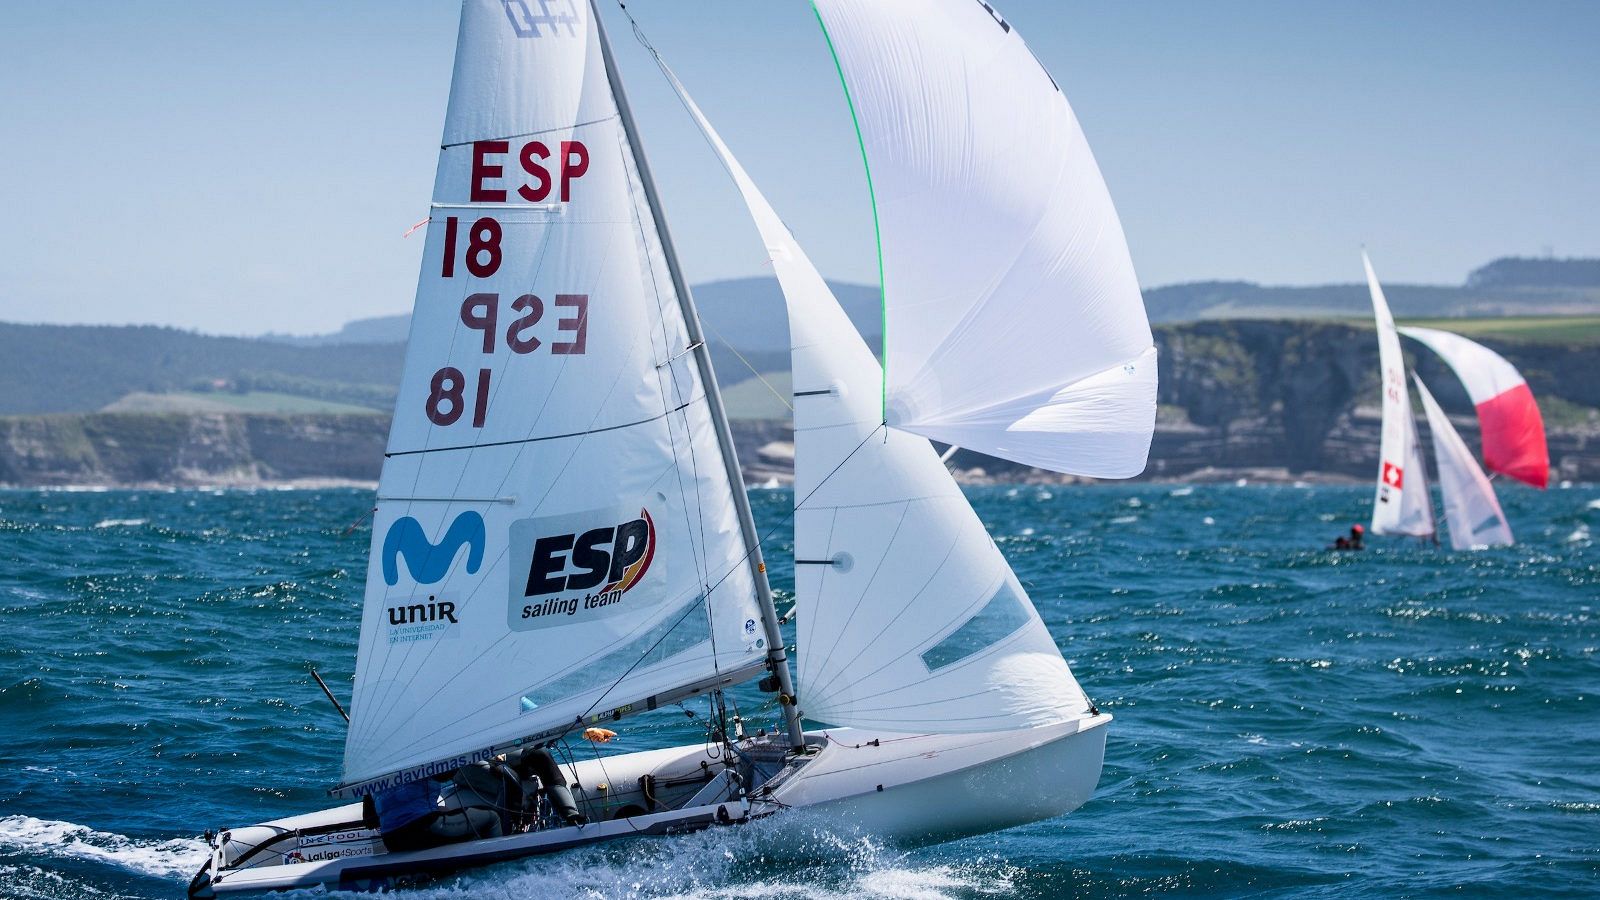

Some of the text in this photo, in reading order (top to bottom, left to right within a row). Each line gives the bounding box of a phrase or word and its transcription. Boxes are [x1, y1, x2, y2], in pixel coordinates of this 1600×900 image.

[470, 140, 590, 203] ESP
[441, 216, 503, 278] 18
[524, 518, 650, 597] ESP
[521, 589, 622, 619] sailing team
[352, 745, 497, 799] www.davidmas.net
